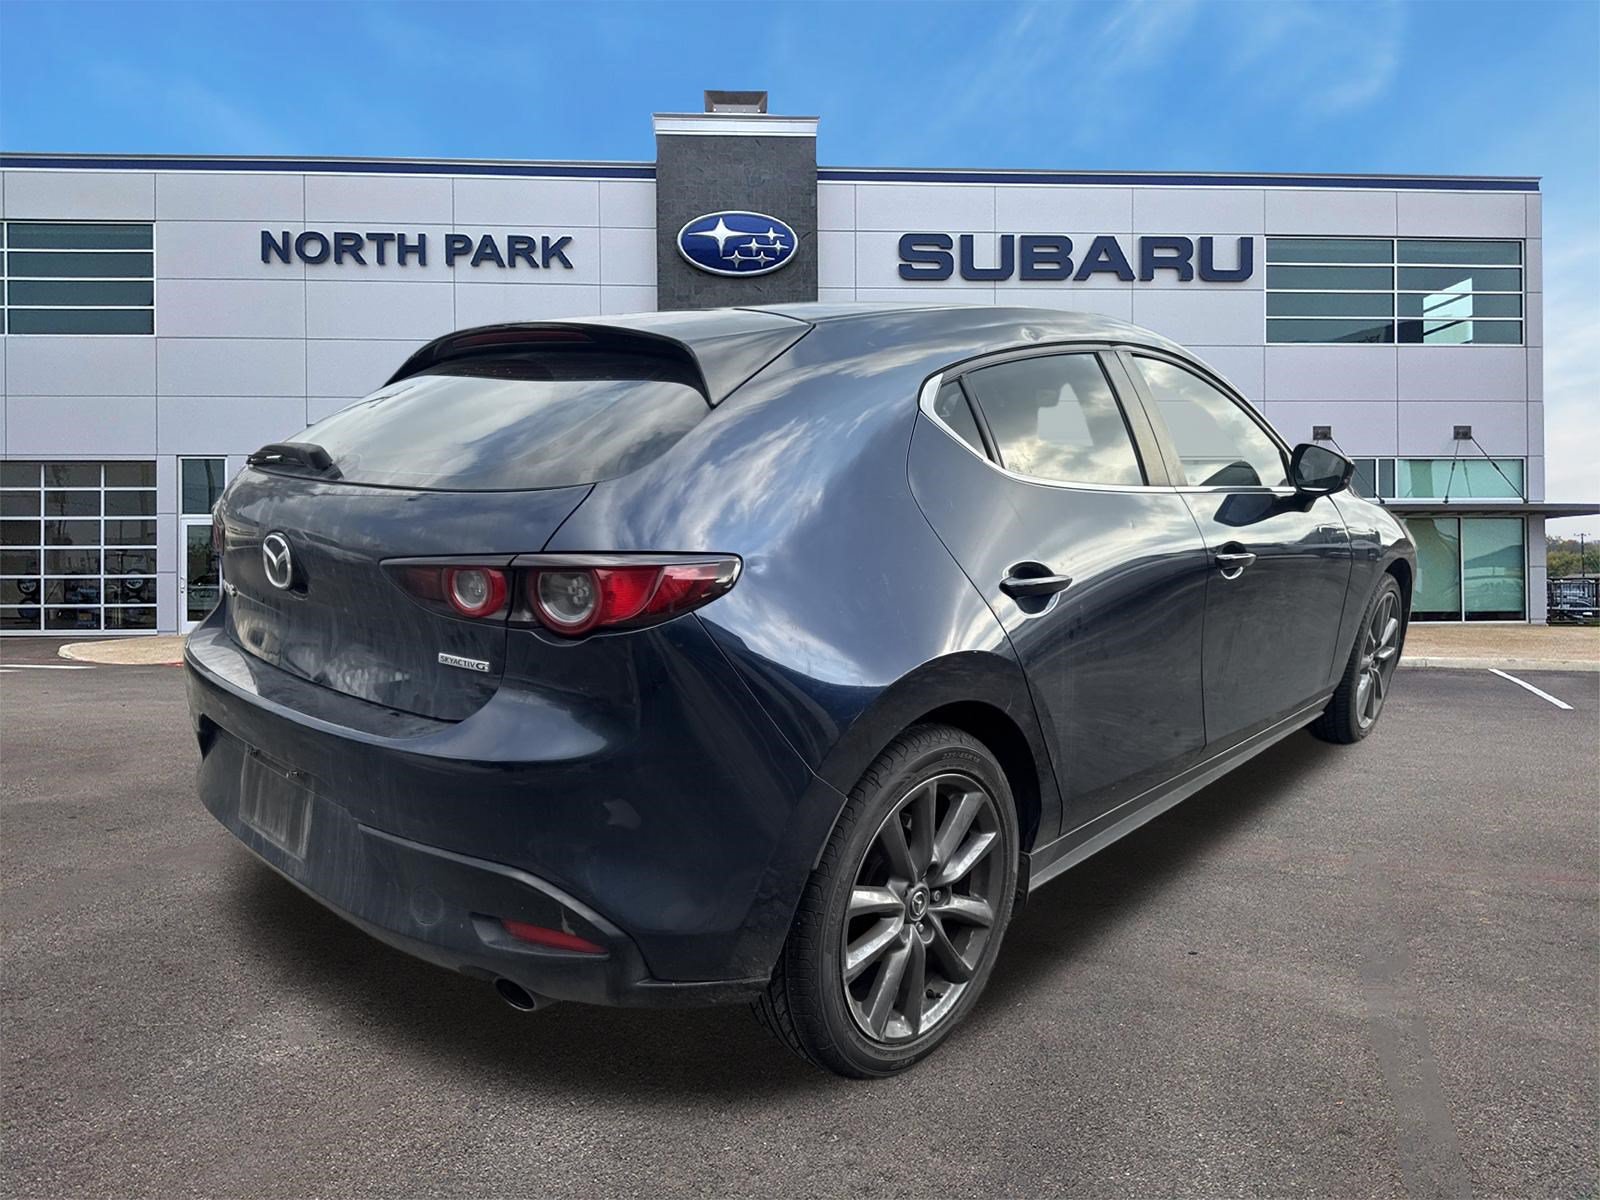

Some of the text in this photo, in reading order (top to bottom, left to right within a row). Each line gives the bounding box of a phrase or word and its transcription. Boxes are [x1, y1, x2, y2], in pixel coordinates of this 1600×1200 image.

[260, 230, 574, 269] NORTH PARK
[898, 232, 1254, 282] SUBARU
